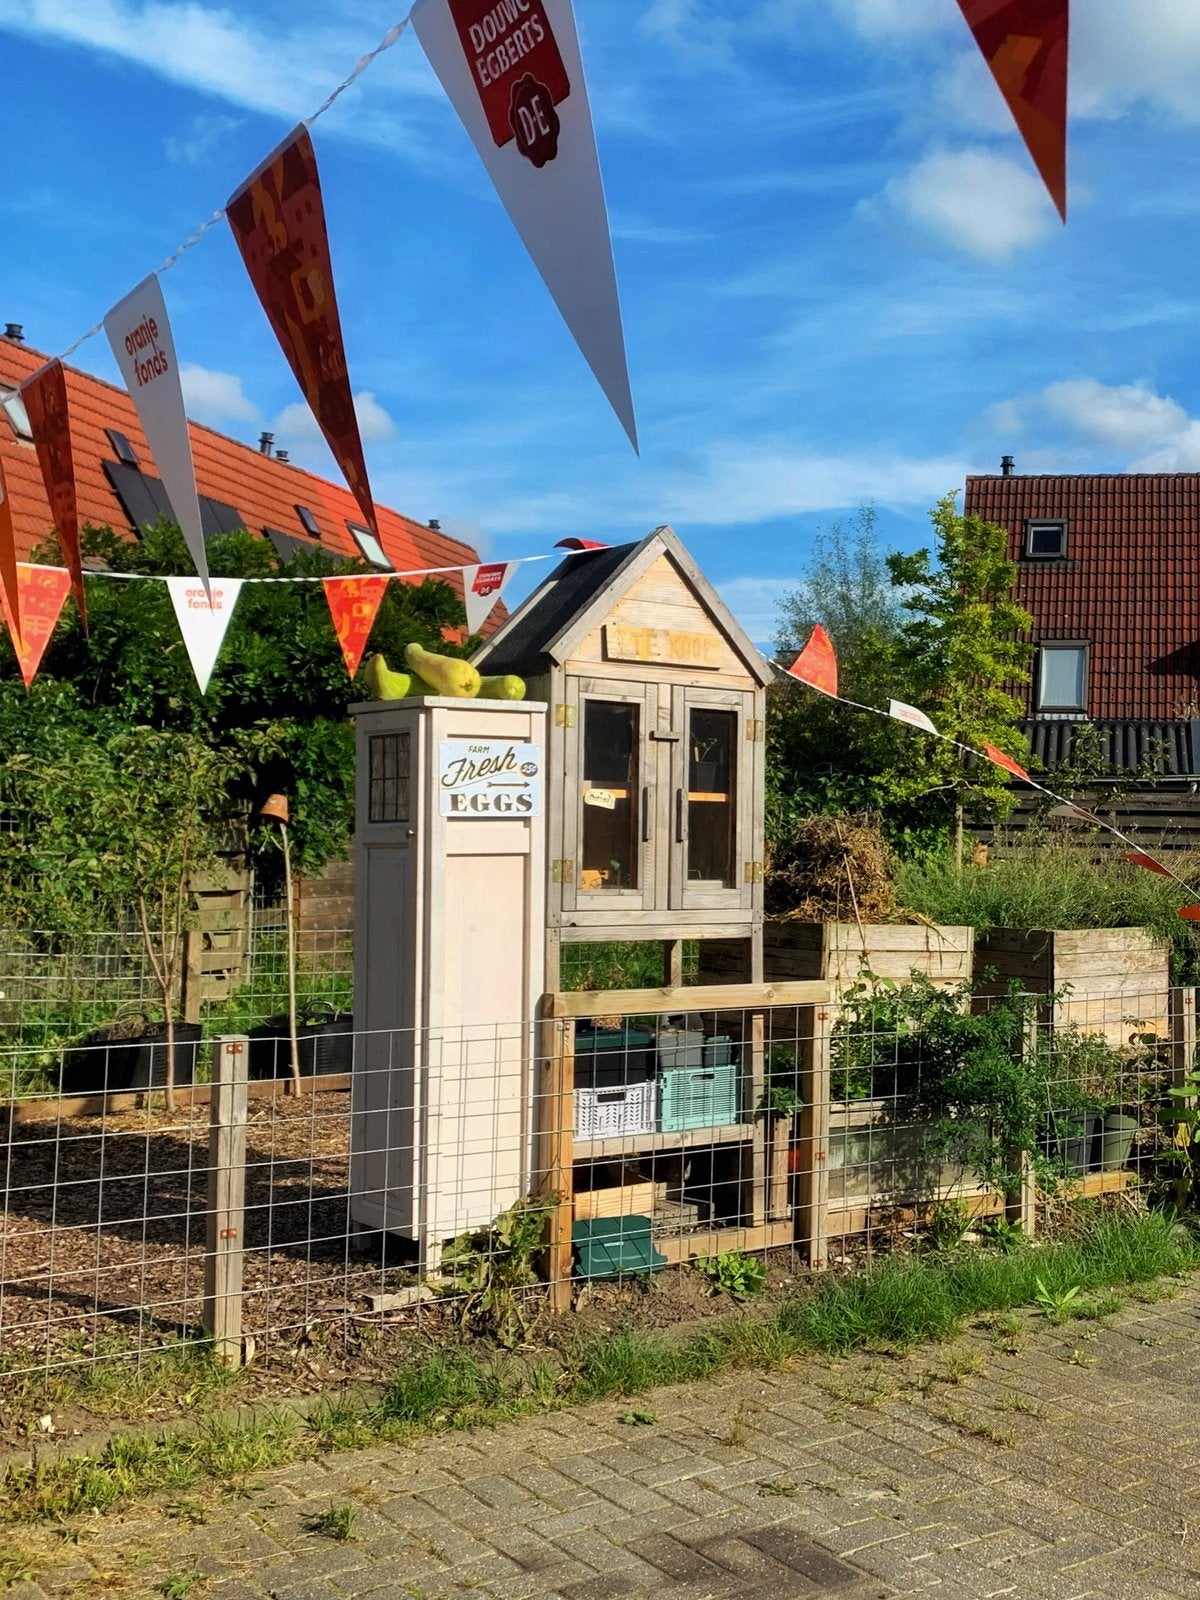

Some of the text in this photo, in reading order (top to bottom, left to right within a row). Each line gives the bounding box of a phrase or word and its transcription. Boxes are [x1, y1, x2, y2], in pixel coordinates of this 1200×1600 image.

[475, 14, 544, 88] EGBERTS
[124, 314, 159, 356] oranje
[134, 345, 168, 387] fonds
[185, 587, 224, 601] oraje
[441, 746, 517, 787] Fresh
[468, 746, 490, 754] FARM
[449, 793, 533, 812] EGGS
